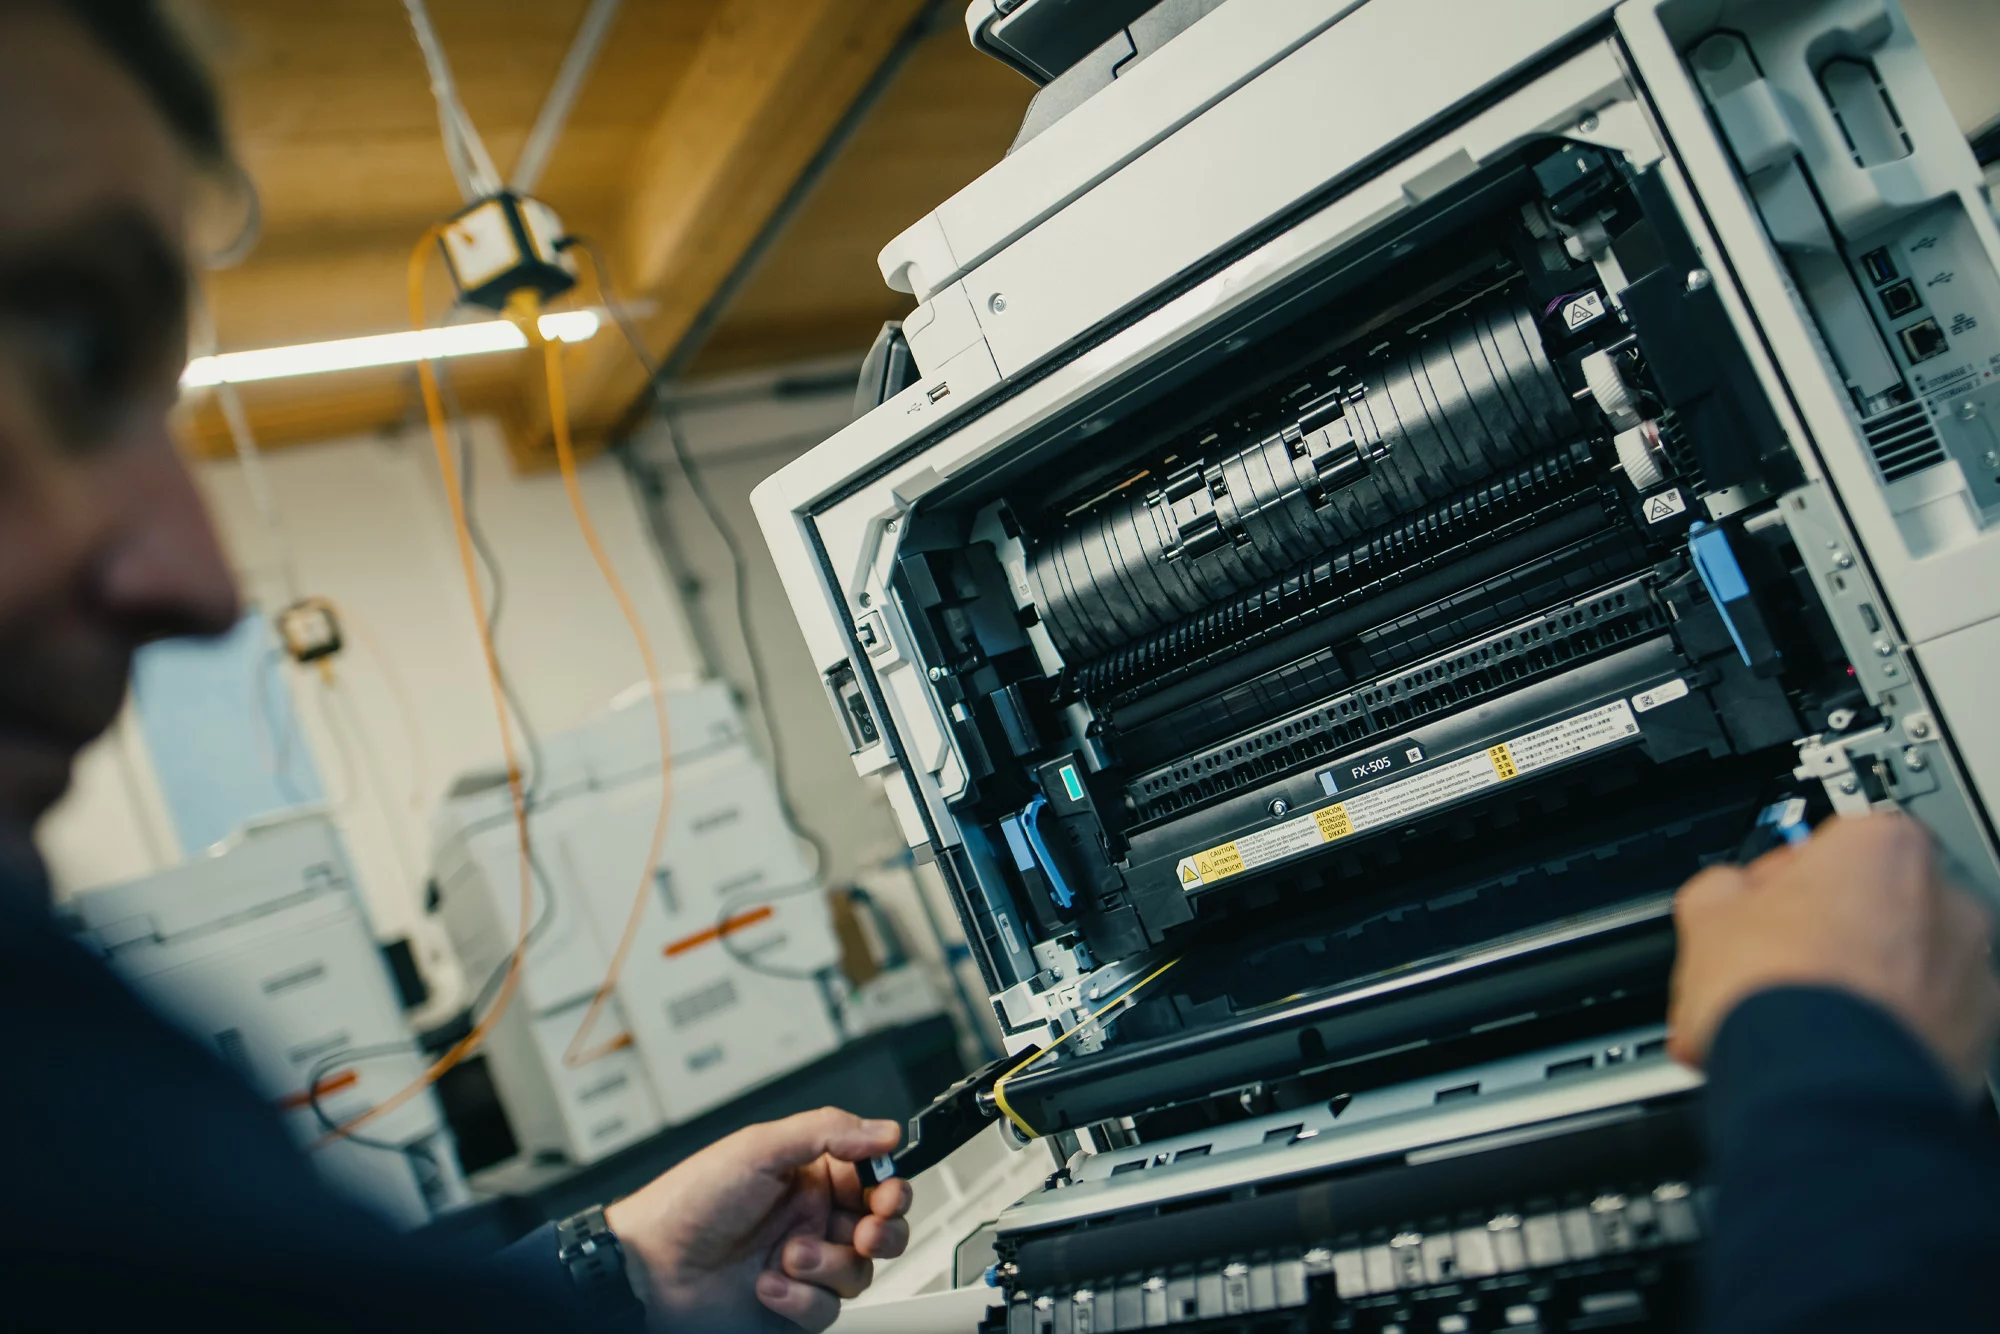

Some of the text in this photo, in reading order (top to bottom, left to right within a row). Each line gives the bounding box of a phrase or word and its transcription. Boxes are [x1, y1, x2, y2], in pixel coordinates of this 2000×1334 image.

[1351, 755, 1391, 779] FX-505
[1317, 806, 1341, 819] ATENCIÓN
[1320, 812, 1346, 827] ATTENZIONE
[1321, 819, 1347, 832] CUIDADO
[1327, 827, 1347, 838] DIKKAT
[1209, 844, 1234, 857] CAUTION
[1213, 853, 1239, 867] ATTENTION
[1216, 862, 1242, 875] VORSICHT
